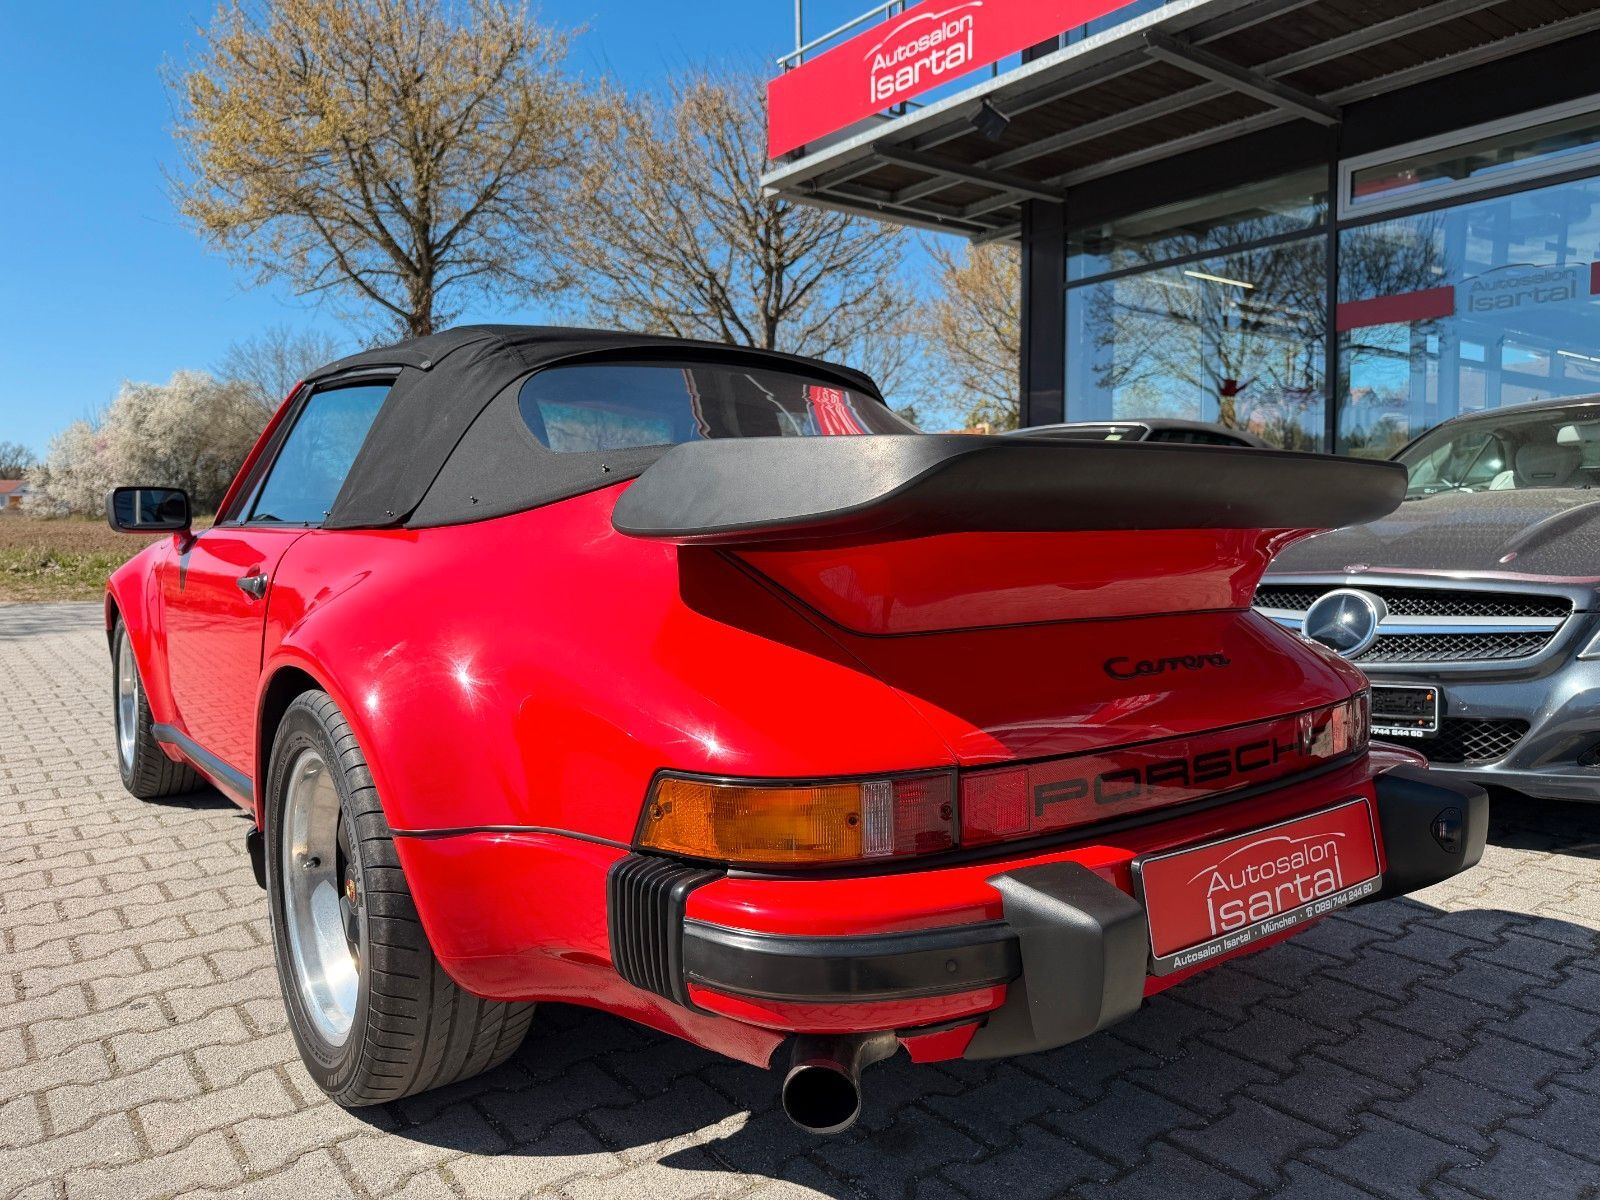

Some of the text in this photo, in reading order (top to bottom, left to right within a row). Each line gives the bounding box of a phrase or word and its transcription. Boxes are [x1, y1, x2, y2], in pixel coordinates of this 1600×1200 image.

[870, 29, 973, 103] Isartal
[871, 15, 973, 74] Autosalon
[1468, 280, 1577, 313] Isartal
[1473, 270, 1576, 293] Autosalon
[1103, 653, 1231, 680] Carrera
[1207, 840, 1338, 898] Autosalon
[1207, 855, 1343, 936] Isartal
[1173, 882, 1373, 969] Autosalon Isartal München 089/744 244 60
